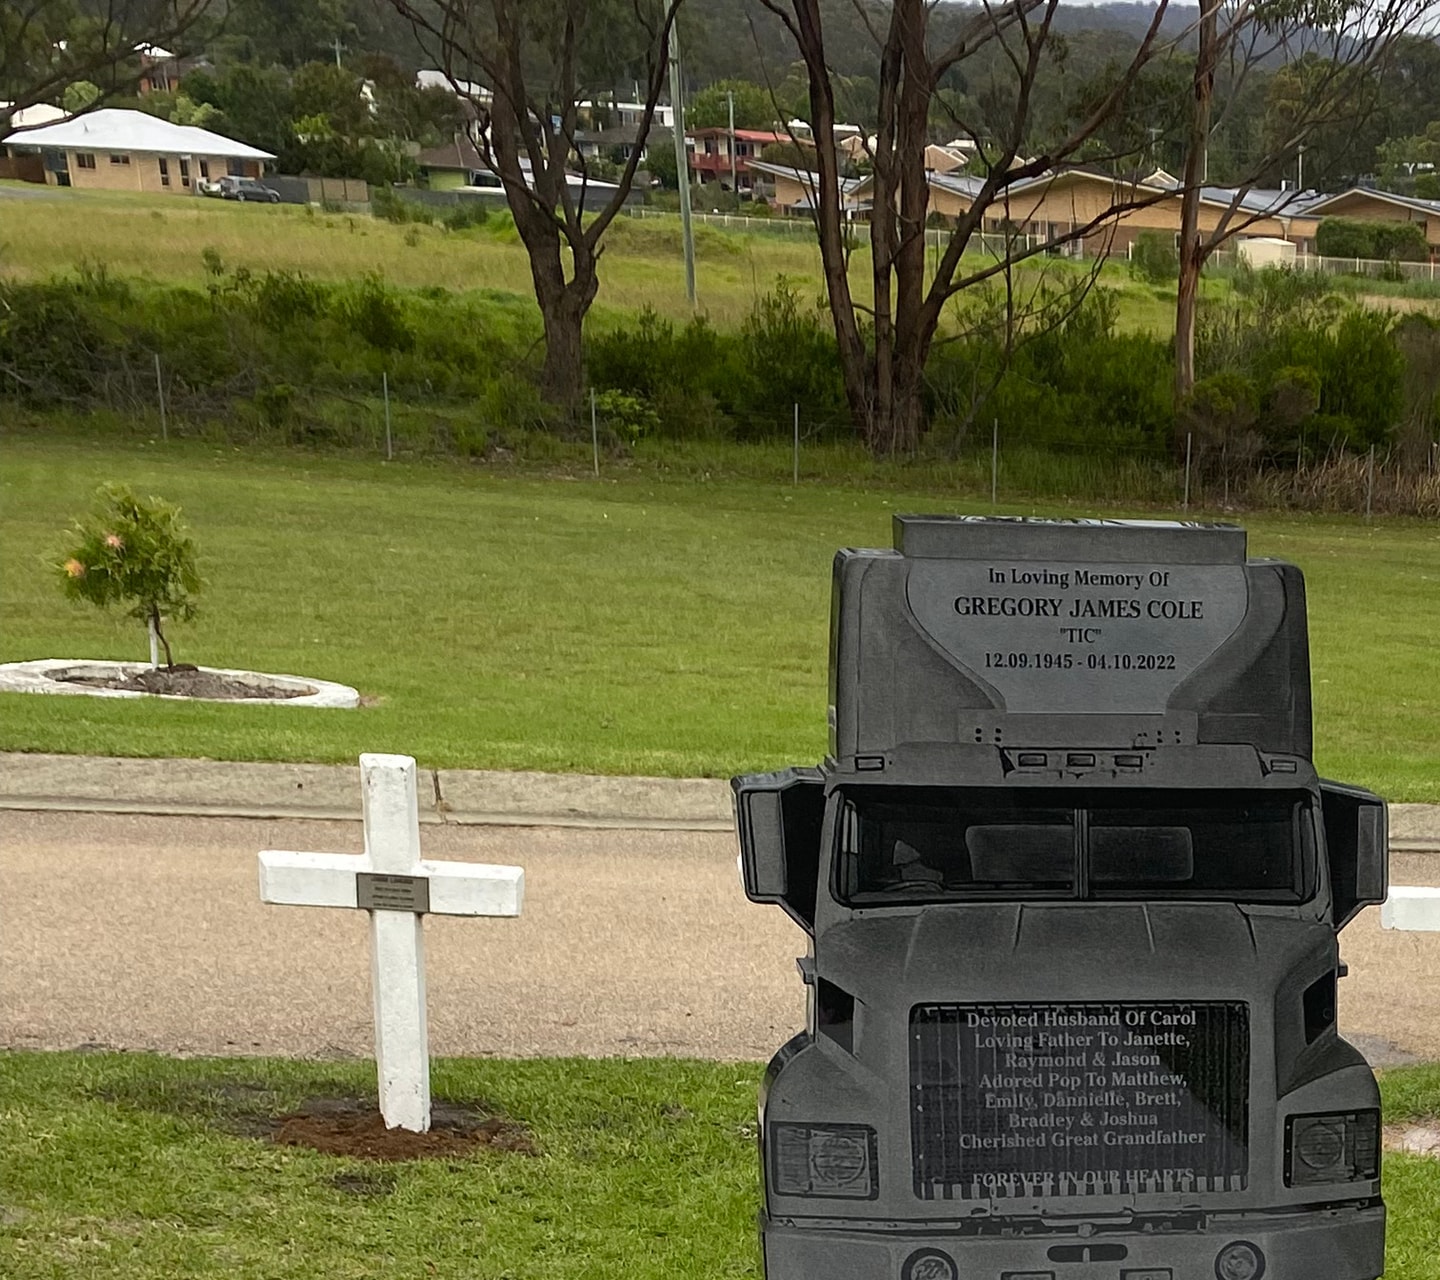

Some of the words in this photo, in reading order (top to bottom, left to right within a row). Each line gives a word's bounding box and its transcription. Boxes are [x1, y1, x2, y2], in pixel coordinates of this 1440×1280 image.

[989, 568, 1005, 584] In
[1012, 568, 1069, 588] Loving
[1075, 571, 1143, 589] Memory
[1150, 571, 1170, 586] Of
[954, 596, 1062, 617] GREGORY
[1069, 599, 1140, 618] JAMES
[1147, 600, 1203, 619] COLE
[1060, 628, 1101, 643] "TIC"
[984, 653, 1072, 669] 12.09.1945
[1088, 654, 1175, 670] 04.10.2022
[967, 1012, 1038, 1027] Devoted
[1044, 1011, 1120, 1026] Husband
[1125, 1011, 1147, 1025] Of
[1150, 1011, 1196, 1025] Carol
[975, 1034, 1033, 1050] Loving
[1039, 1033, 1093, 1047] Father
[1098, 1033, 1118, 1046] To
[1123, 1032, 1190, 1047] Janette,
[1005, 1053, 1087, 1071] Raymond
[1093, 1053, 1105, 1066] &
[1111, 1052, 1160, 1066] Jason
[979, 1074, 1042, 1088] Adored
[1049, 1074, 1081, 1090] Pop
[1085, 1073, 1106, 1086] To
[1111, 1072, 1187, 1088] Matthew,
[985, 1094, 1038, 1111] Emily,
[1044, 1092, 1129, 1108] Dannielle,
[1135, 1092, 1181, 1106] Brett,
[1009, 1114, 1075, 1130] Bradley
[1080, 1113, 1093, 1126] &
[1100, 1112, 1158, 1126] Joshua
[960, 1133, 1046, 1149] Cherished
[1051, 1132, 1098, 1147] Great
[1103, 1130, 1206, 1145] Grandfather
